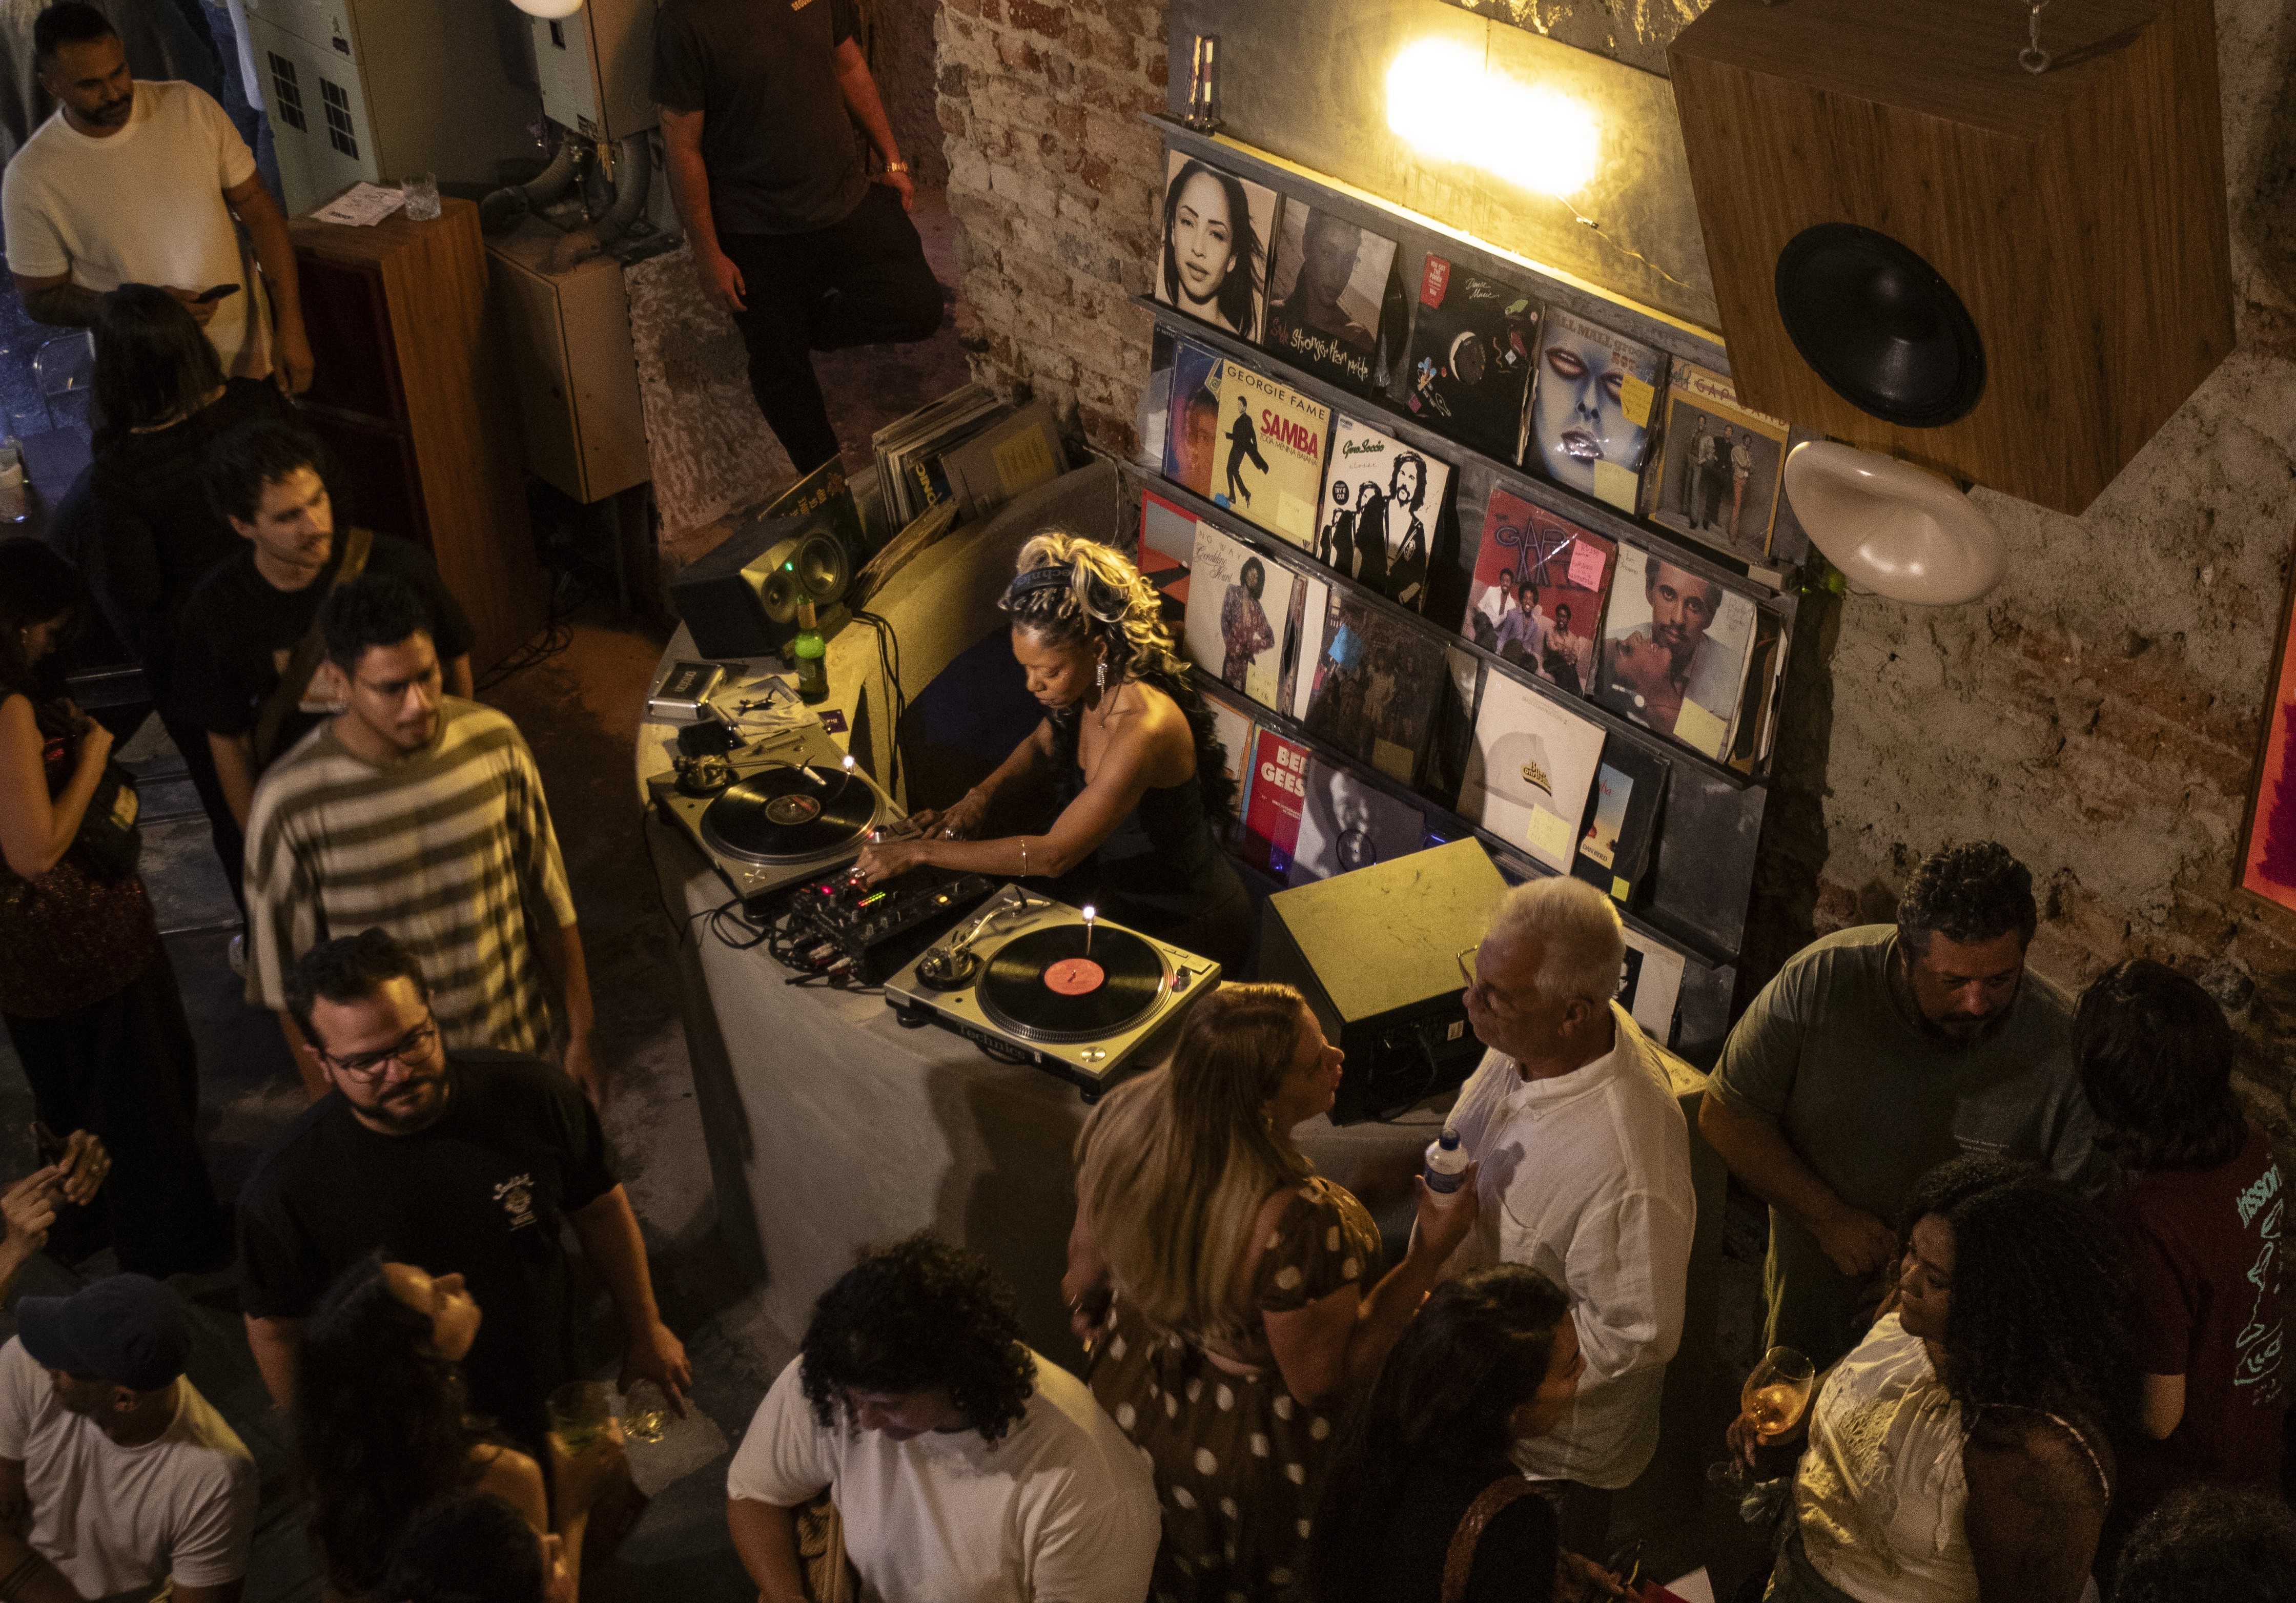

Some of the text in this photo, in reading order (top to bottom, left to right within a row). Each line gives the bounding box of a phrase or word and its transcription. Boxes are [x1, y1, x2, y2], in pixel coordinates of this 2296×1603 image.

[1465, 277, 1491, 290] Dance
[1290, 328, 1328, 361] Stronger
[1347, 356, 1369, 382] pride
[1227, 366, 1325, 420] GEORGIE FAME
[1260, 409, 1318, 460] SAMBA
[1260, 433, 1317, 466] TODA MENINA BAIANA
[1342, 438, 1385, 459] Gino Soccio
[1199, 530, 1242, 560] NO WAY
[1261, 762, 1305, 797] GEES
[959, 1023, 1025, 1060] Technics
